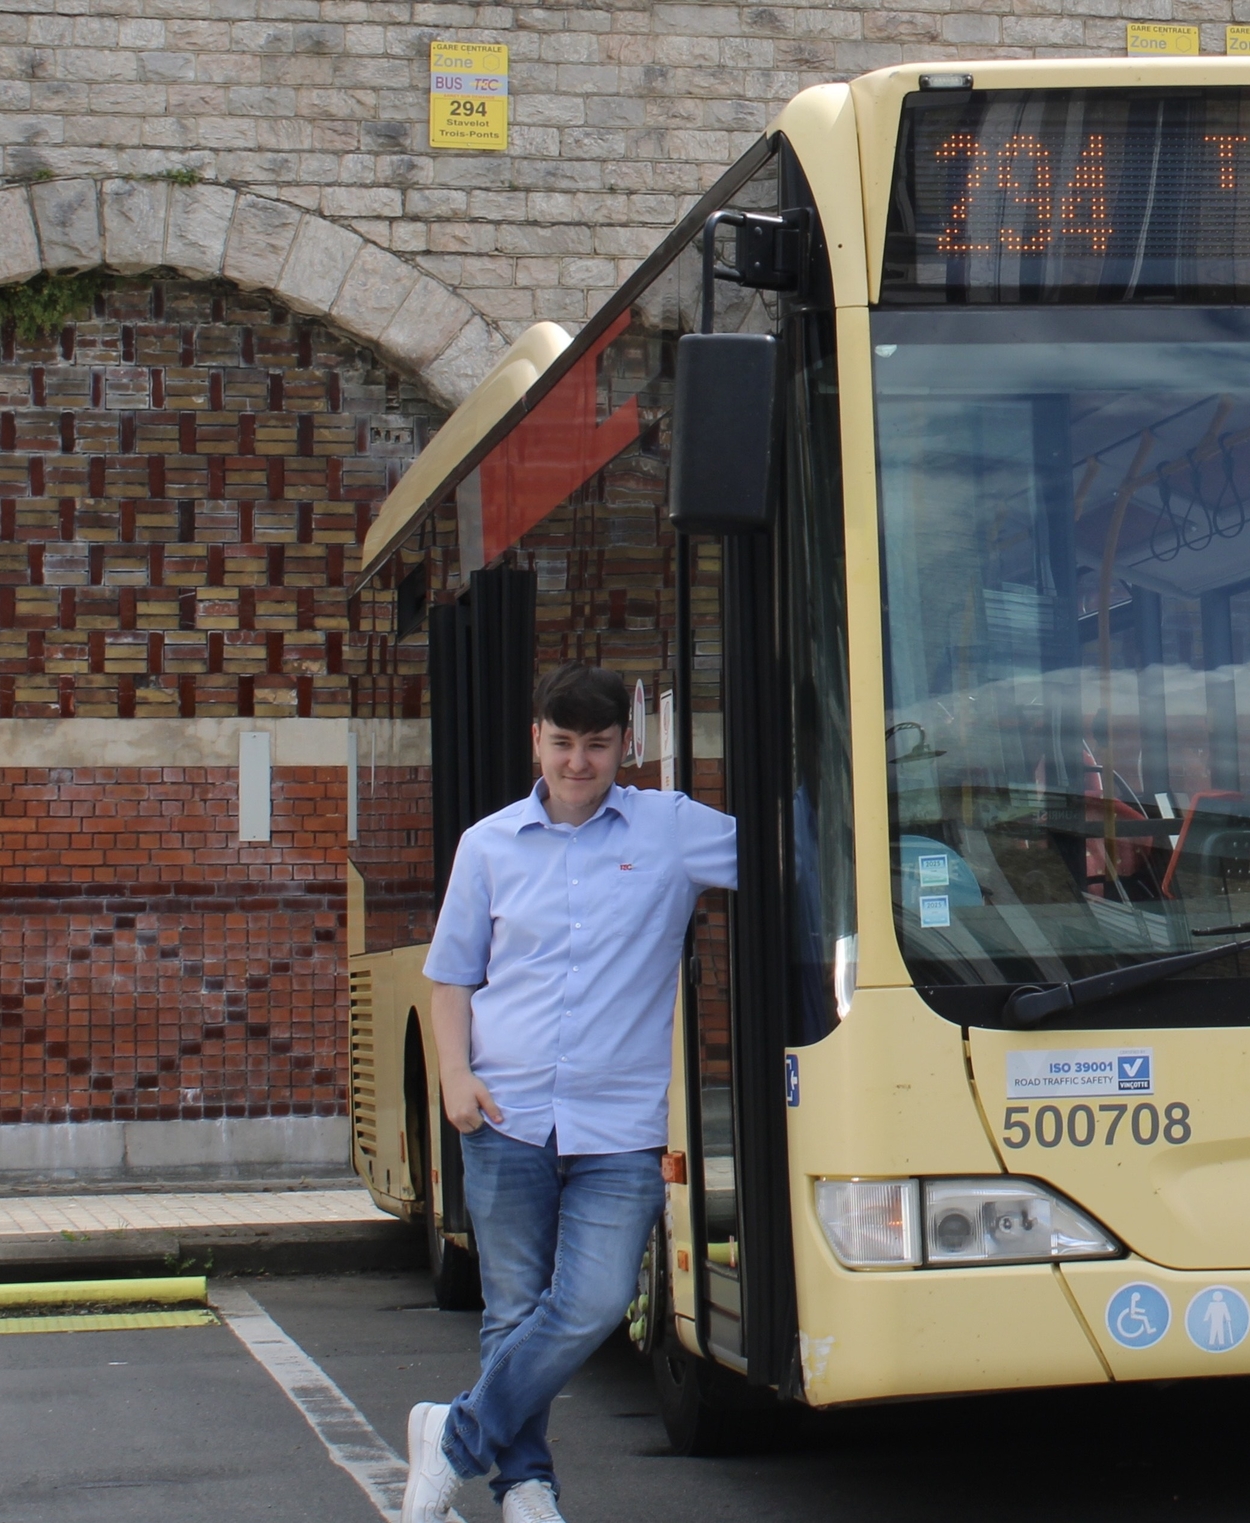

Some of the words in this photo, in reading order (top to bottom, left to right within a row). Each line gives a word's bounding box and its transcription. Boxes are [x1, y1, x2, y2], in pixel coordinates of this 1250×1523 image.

[1153, 26, 1191, 34] CENTRALE
[1230, 27, 1249, 35] GARE
[460, 44, 502, 53] CENTRALE
[1130, 36, 1167, 50] Zone
[433, 54, 473, 68] Zone
[435, 76, 462, 90] BUS
[474, 78, 499, 91] TEC
[450, 101, 487, 117] 294
[446, 118, 490, 127] Stavelot
[439, 130, 500, 138] Trois-Ponts
[935, 134, 1113, 252] 294
[1049, 1062, 1071, 1074] ISO
[1074, 1061, 1113, 1073] 39001
[1014, 1077, 1041, 1087] ROAD
[1042, 1076, 1079, 1086] TRAFFIC
[1080, 1075, 1114, 1085] SAFETY
[1002, 1101, 1192, 1149] 500708
